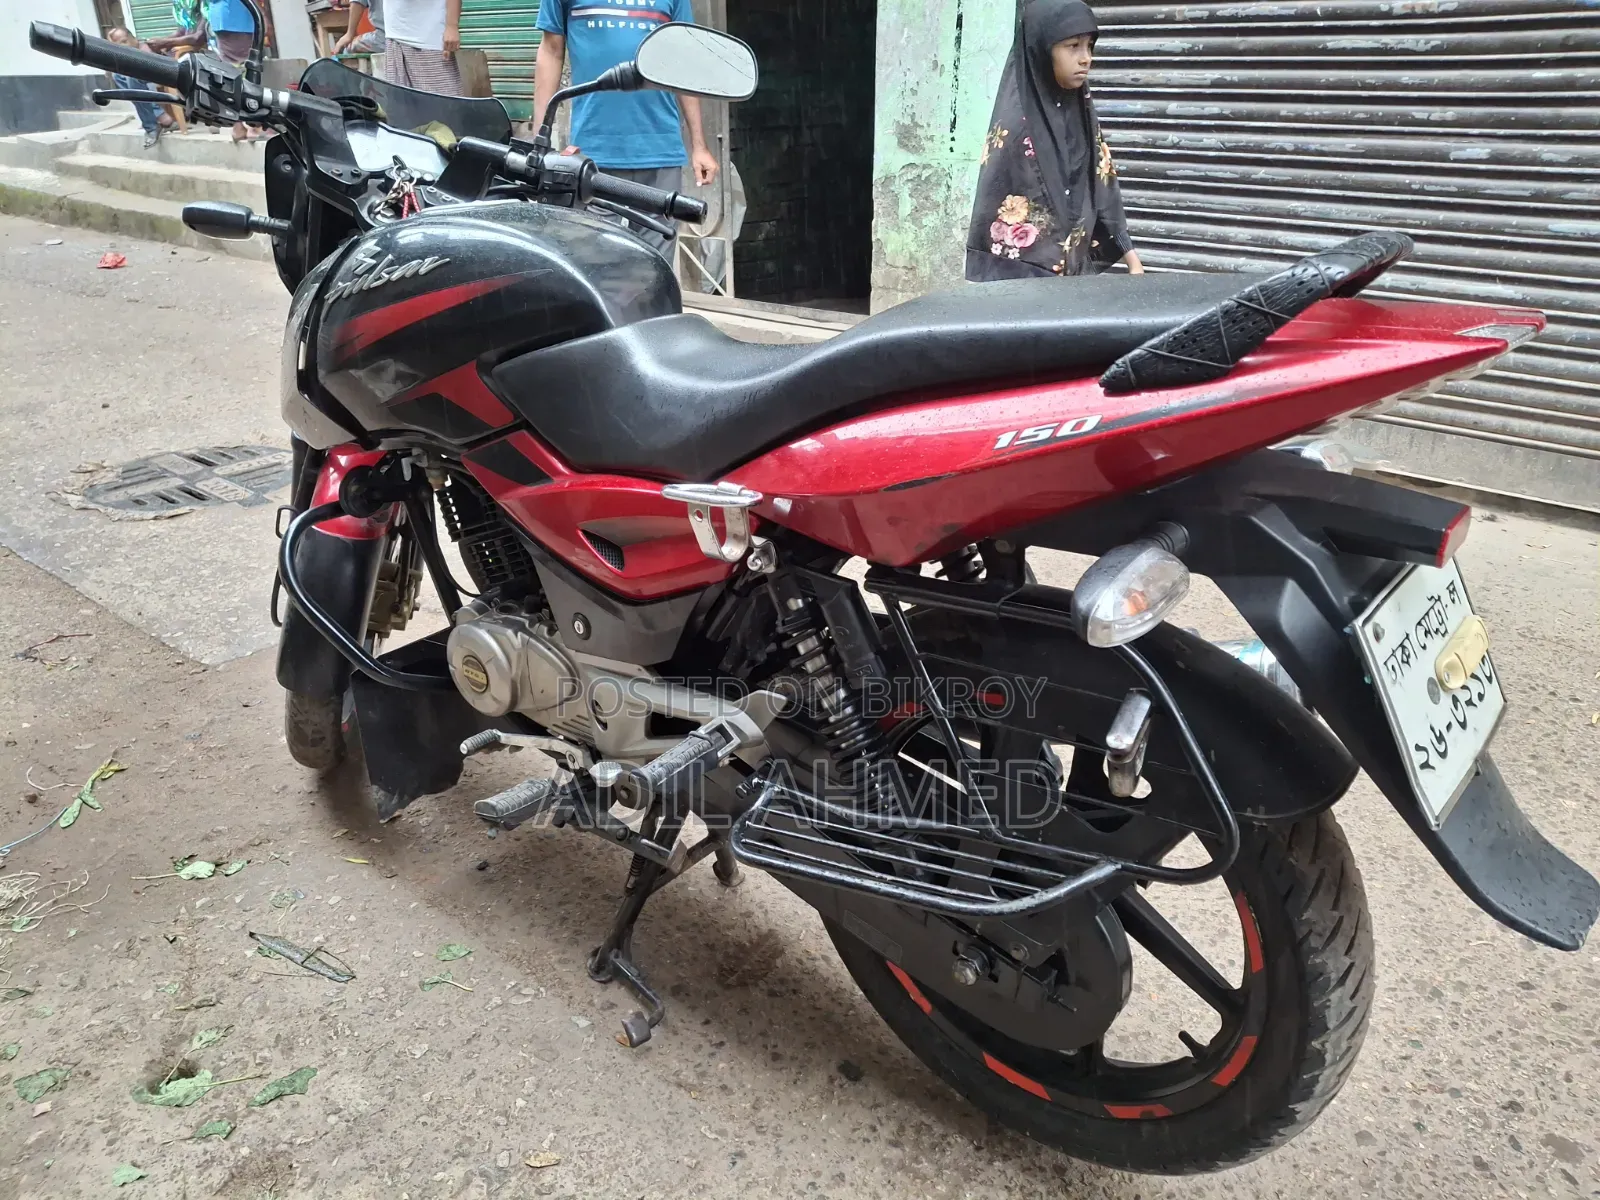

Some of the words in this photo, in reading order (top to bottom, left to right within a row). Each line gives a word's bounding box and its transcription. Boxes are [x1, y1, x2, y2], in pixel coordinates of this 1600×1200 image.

[587, 20, 657, 31] HILFIGE
[993, 414, 1103, 450] 150
[1383, 631, 1418, 682] ঢাকা
